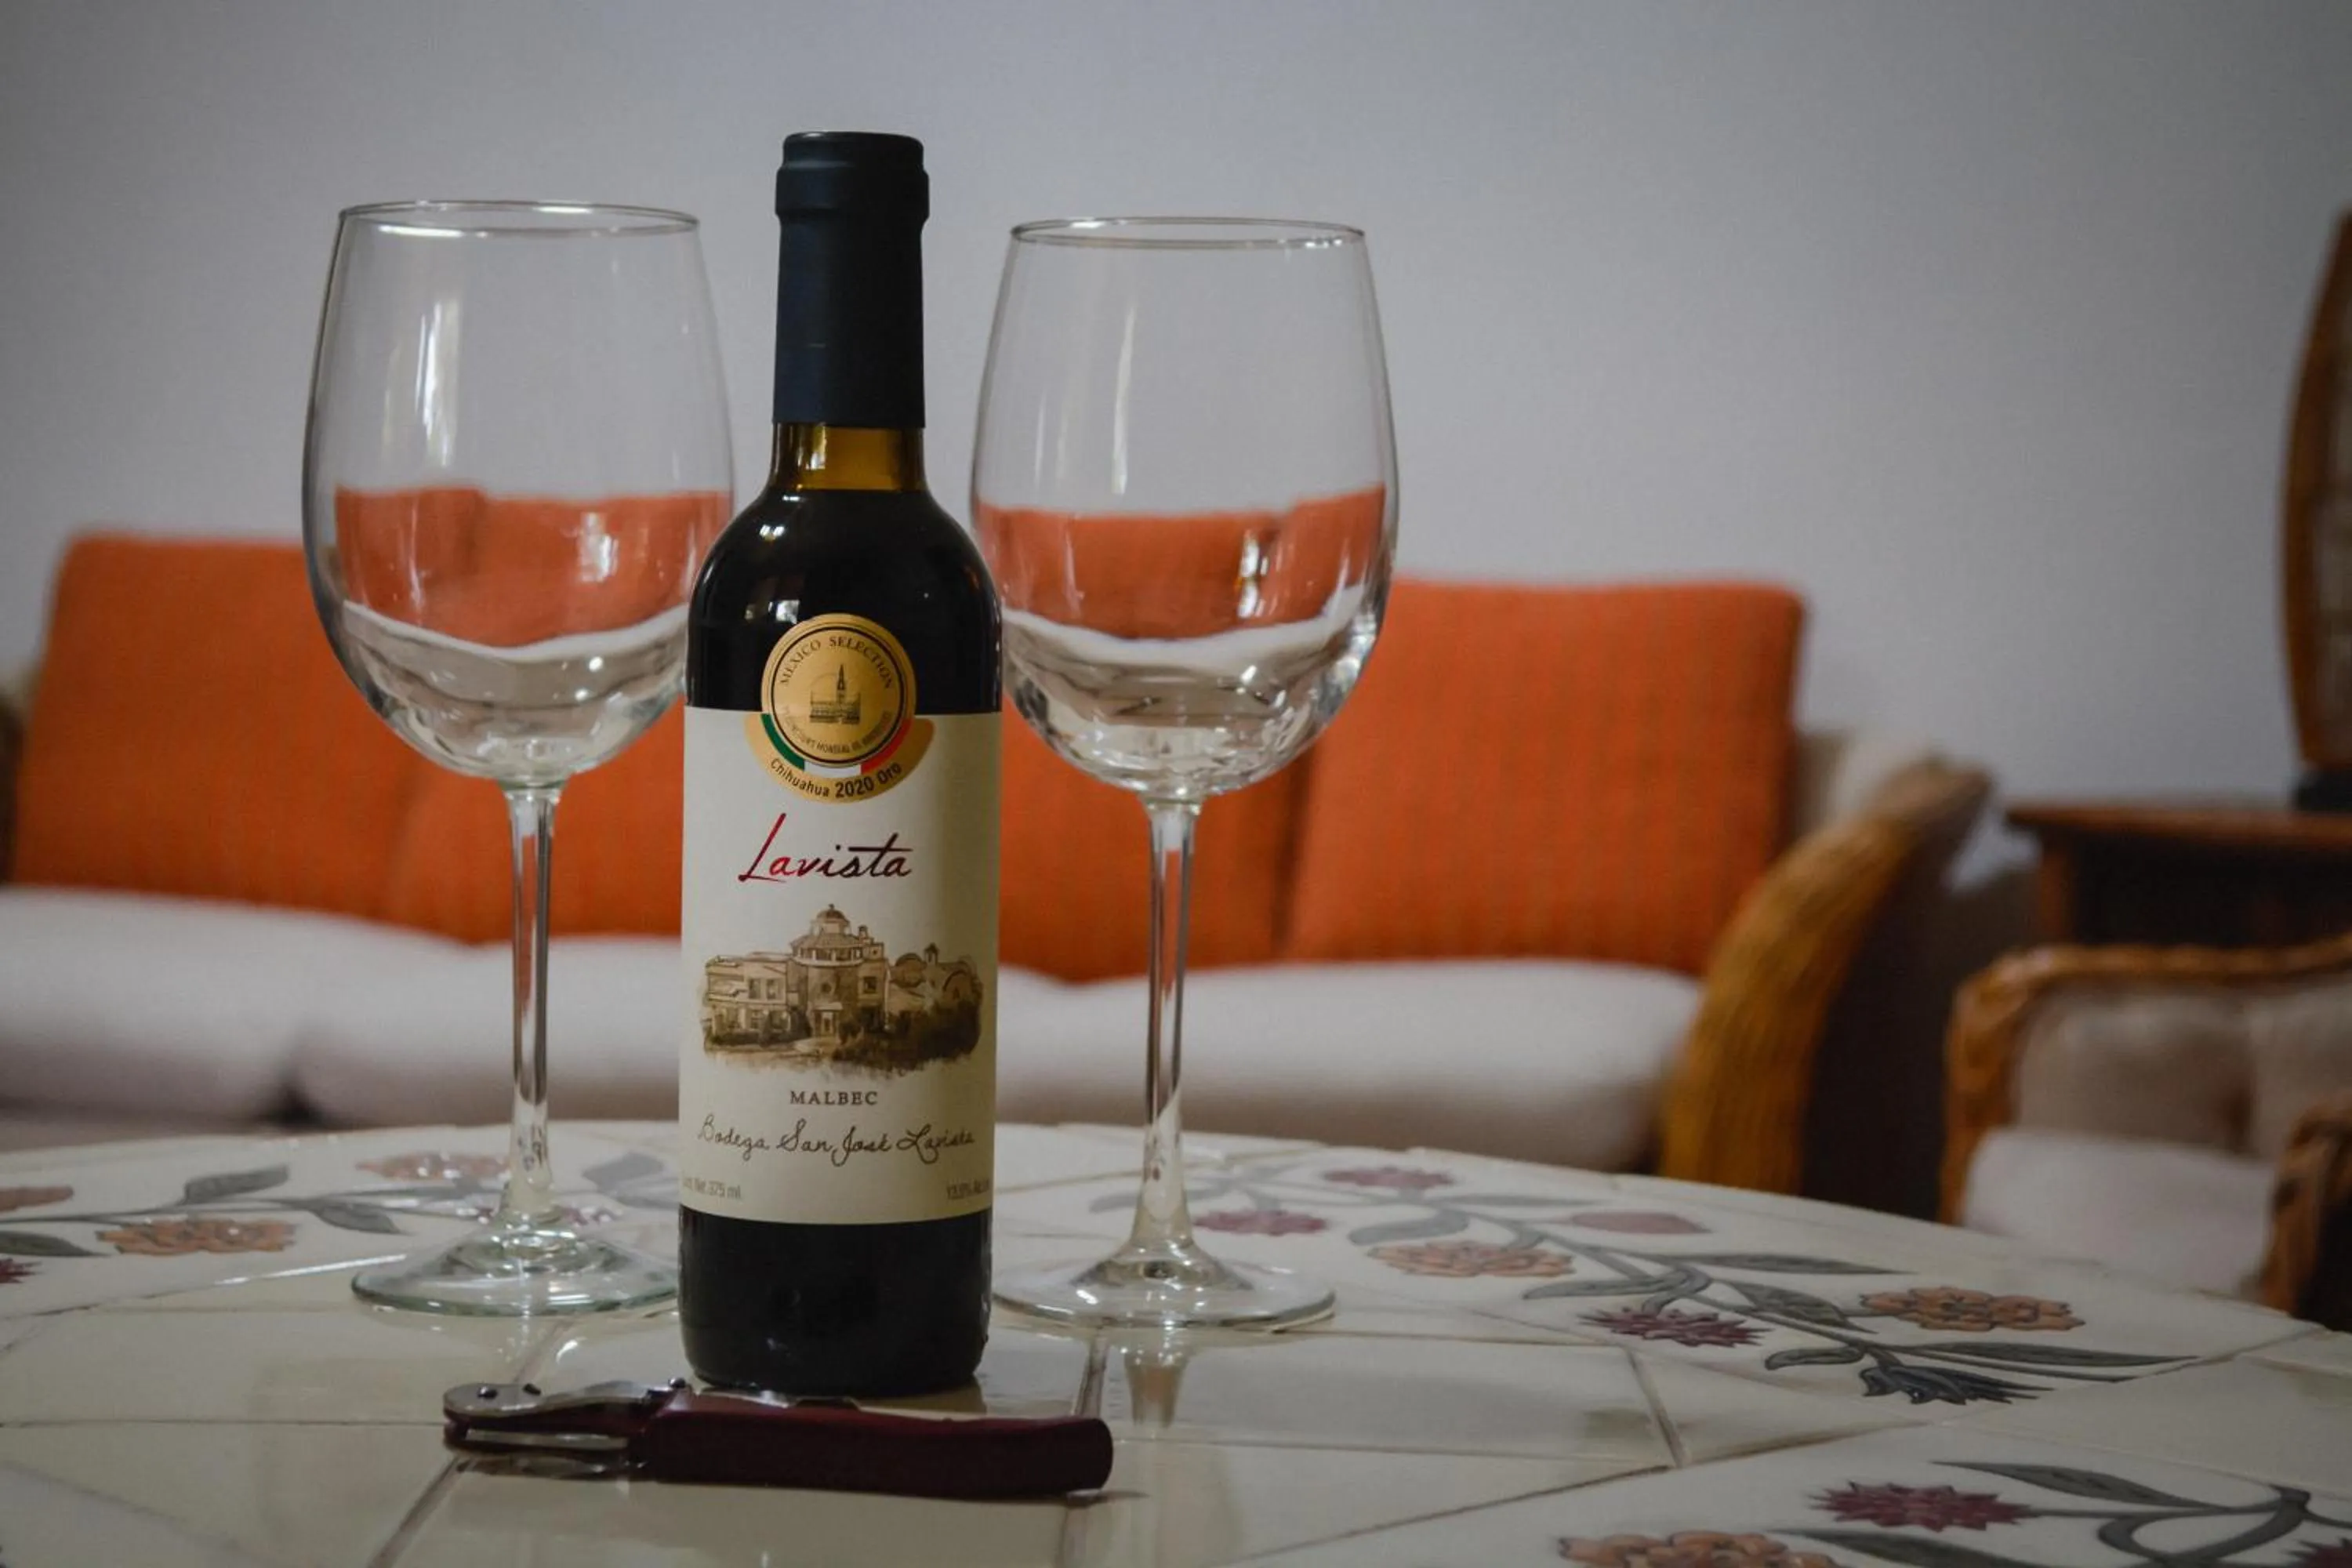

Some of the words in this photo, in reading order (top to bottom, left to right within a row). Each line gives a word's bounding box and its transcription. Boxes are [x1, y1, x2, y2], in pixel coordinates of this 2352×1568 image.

[780, 639, 822, 686] MEXICO
[829, 636, 893, 688] SELECTION
[771, 758, 830, 797] Chihuahua
[835, 779, 875, 798] 2020
[877, 762, 902, 784] Oro
[738, 812, 914, 883] Lavista
[789, 1091, 879, 1105] MALBEC
[698, 1113, 770, 1162] Bodega
[776, 1118, 833, 1152] San
[896, 1123, 976, 1164] Lavista
